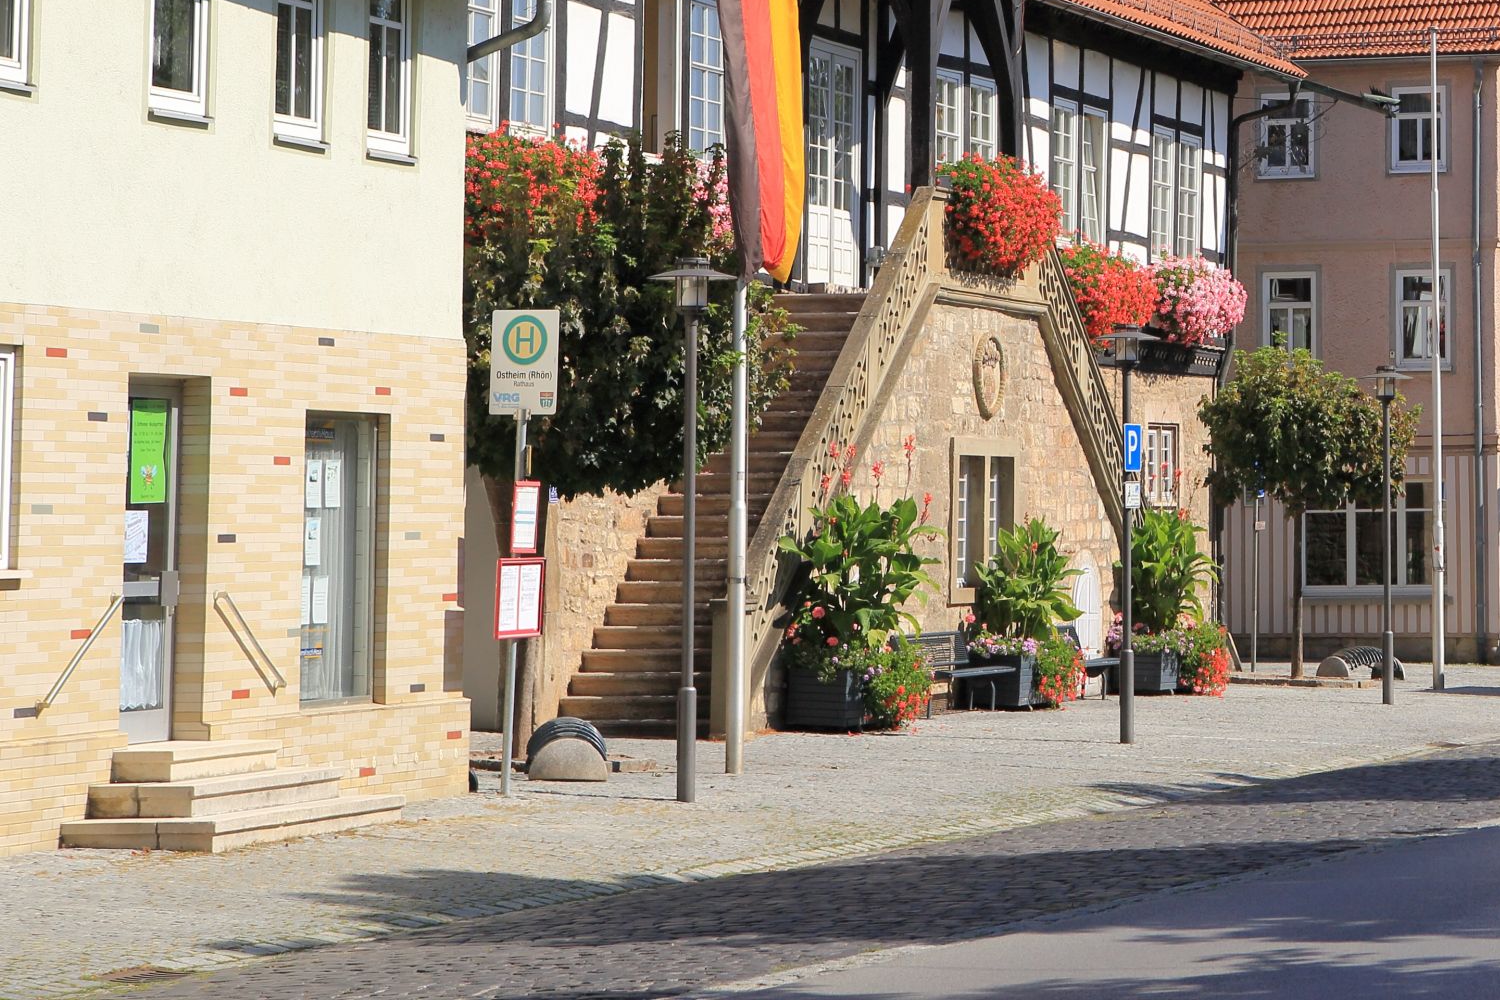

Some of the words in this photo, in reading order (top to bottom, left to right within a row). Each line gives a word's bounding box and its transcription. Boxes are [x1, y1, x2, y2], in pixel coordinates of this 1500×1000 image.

[516, 326, 534, 354] H
[496, 370, 526, 379] Ostheim
[528, 370, 552, 380] (Rhön)
[1128, 430, 1138, 465] P
